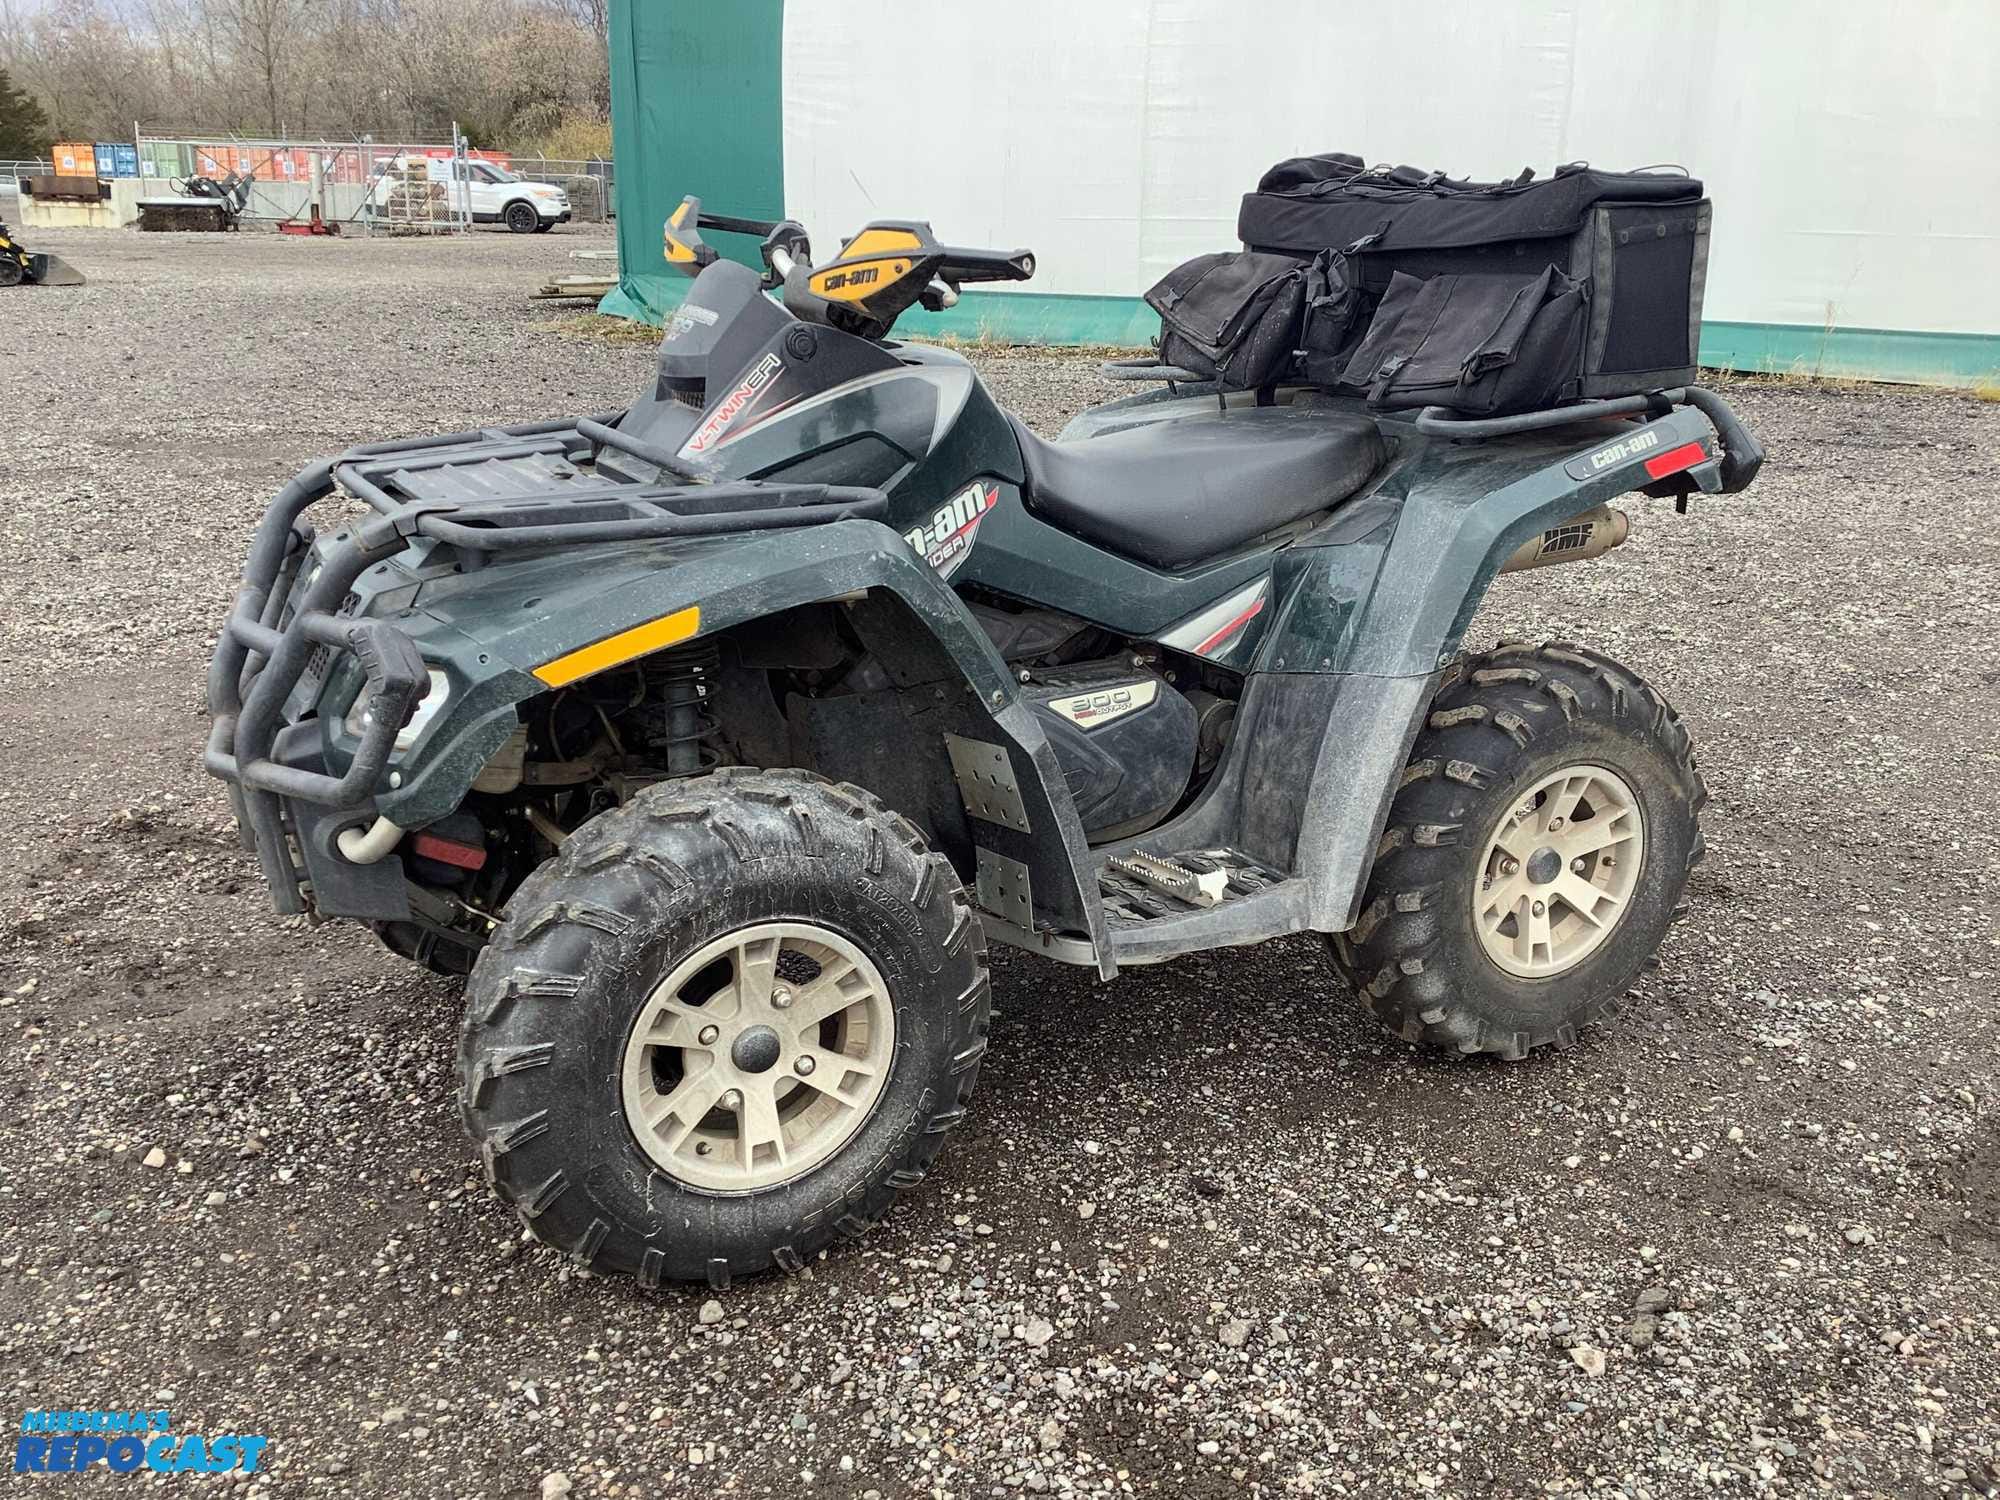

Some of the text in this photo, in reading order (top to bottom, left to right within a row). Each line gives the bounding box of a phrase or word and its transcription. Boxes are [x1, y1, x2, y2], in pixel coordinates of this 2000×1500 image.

[824, 267, 878, 291] can-am
[1591, 430, 1658, 470] can-am
[903, 482, 987, 557] n-am
